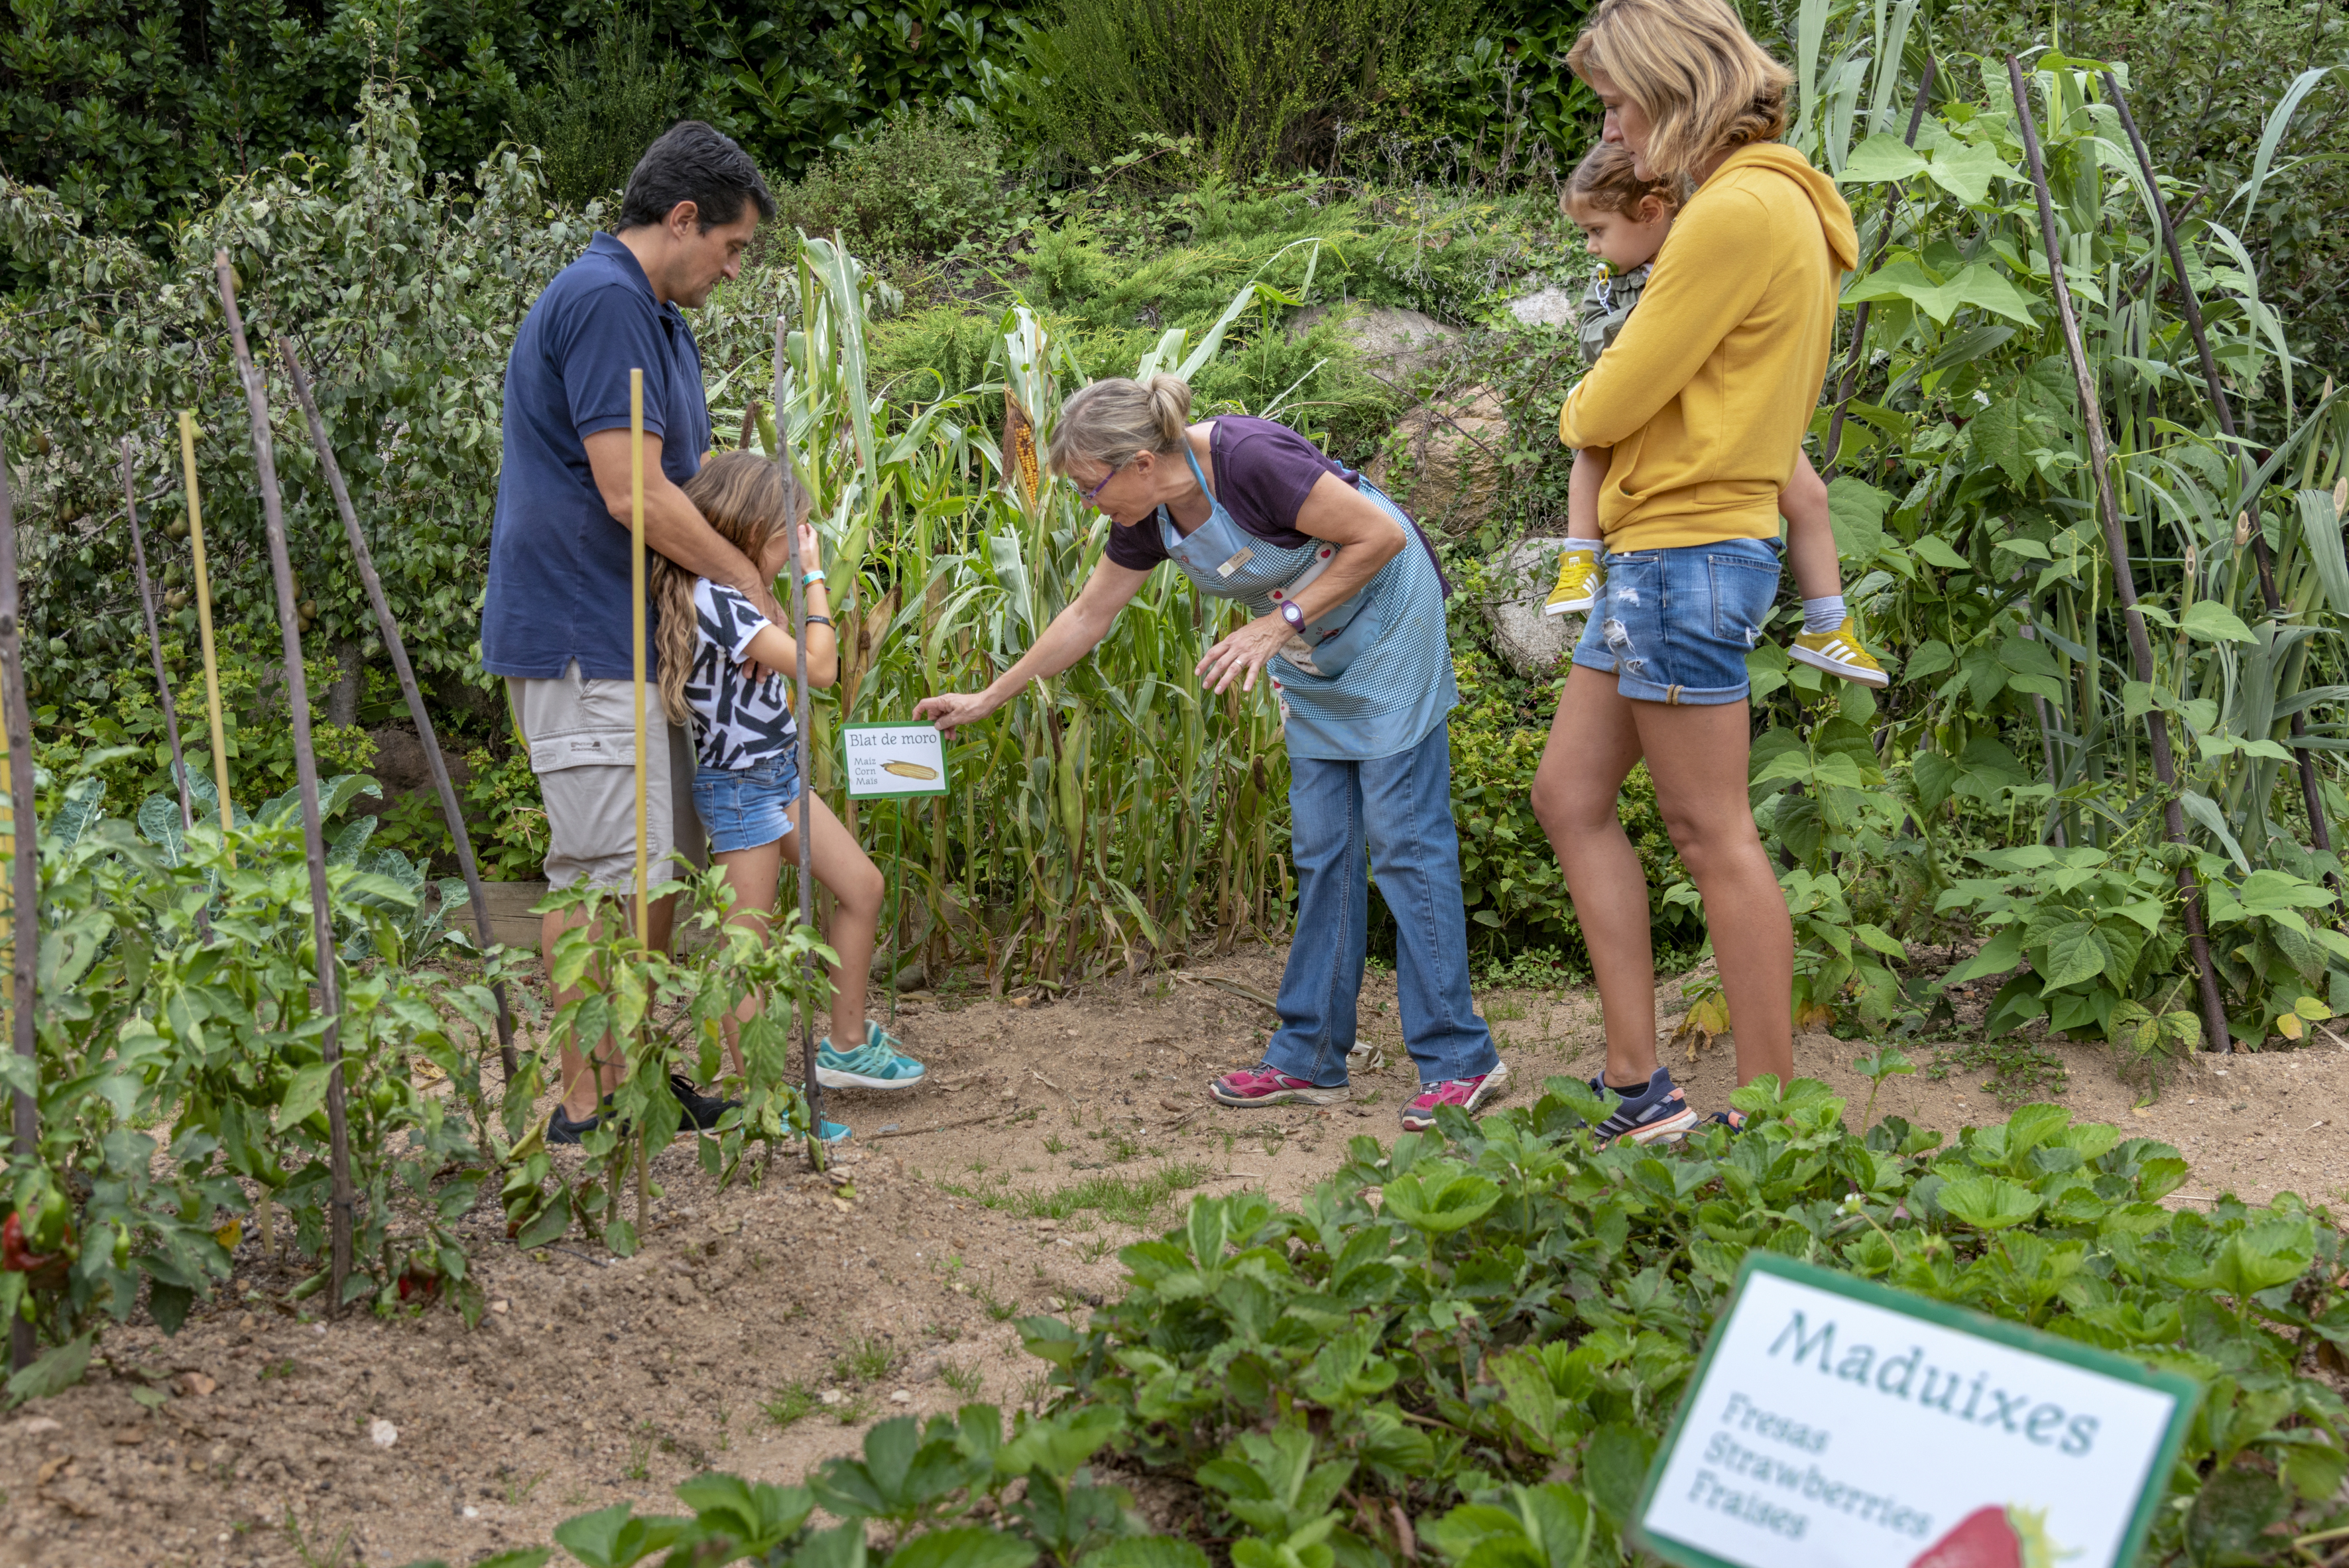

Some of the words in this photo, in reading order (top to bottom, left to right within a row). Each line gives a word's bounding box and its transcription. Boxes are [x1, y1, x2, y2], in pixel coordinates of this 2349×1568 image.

[1233, 552, 1244, 562] CATI
[849, 734, 877, 747] Blat
[881, 733, 897, 745] de
[901, 734, 937, 745] moro
[854, 757, 876, 766] Maíz
[855, 767, 876, 776] Corn
[856, 777, 878, 786] Maïs
[1767, 1309, 2100, 1457] Maduixes
[1721, 1392, 1829, 1454] Fresas
[1703, 1432, 1933, 1539] Strawberries
[1688, 1470, 1809, 1540] Fraises
